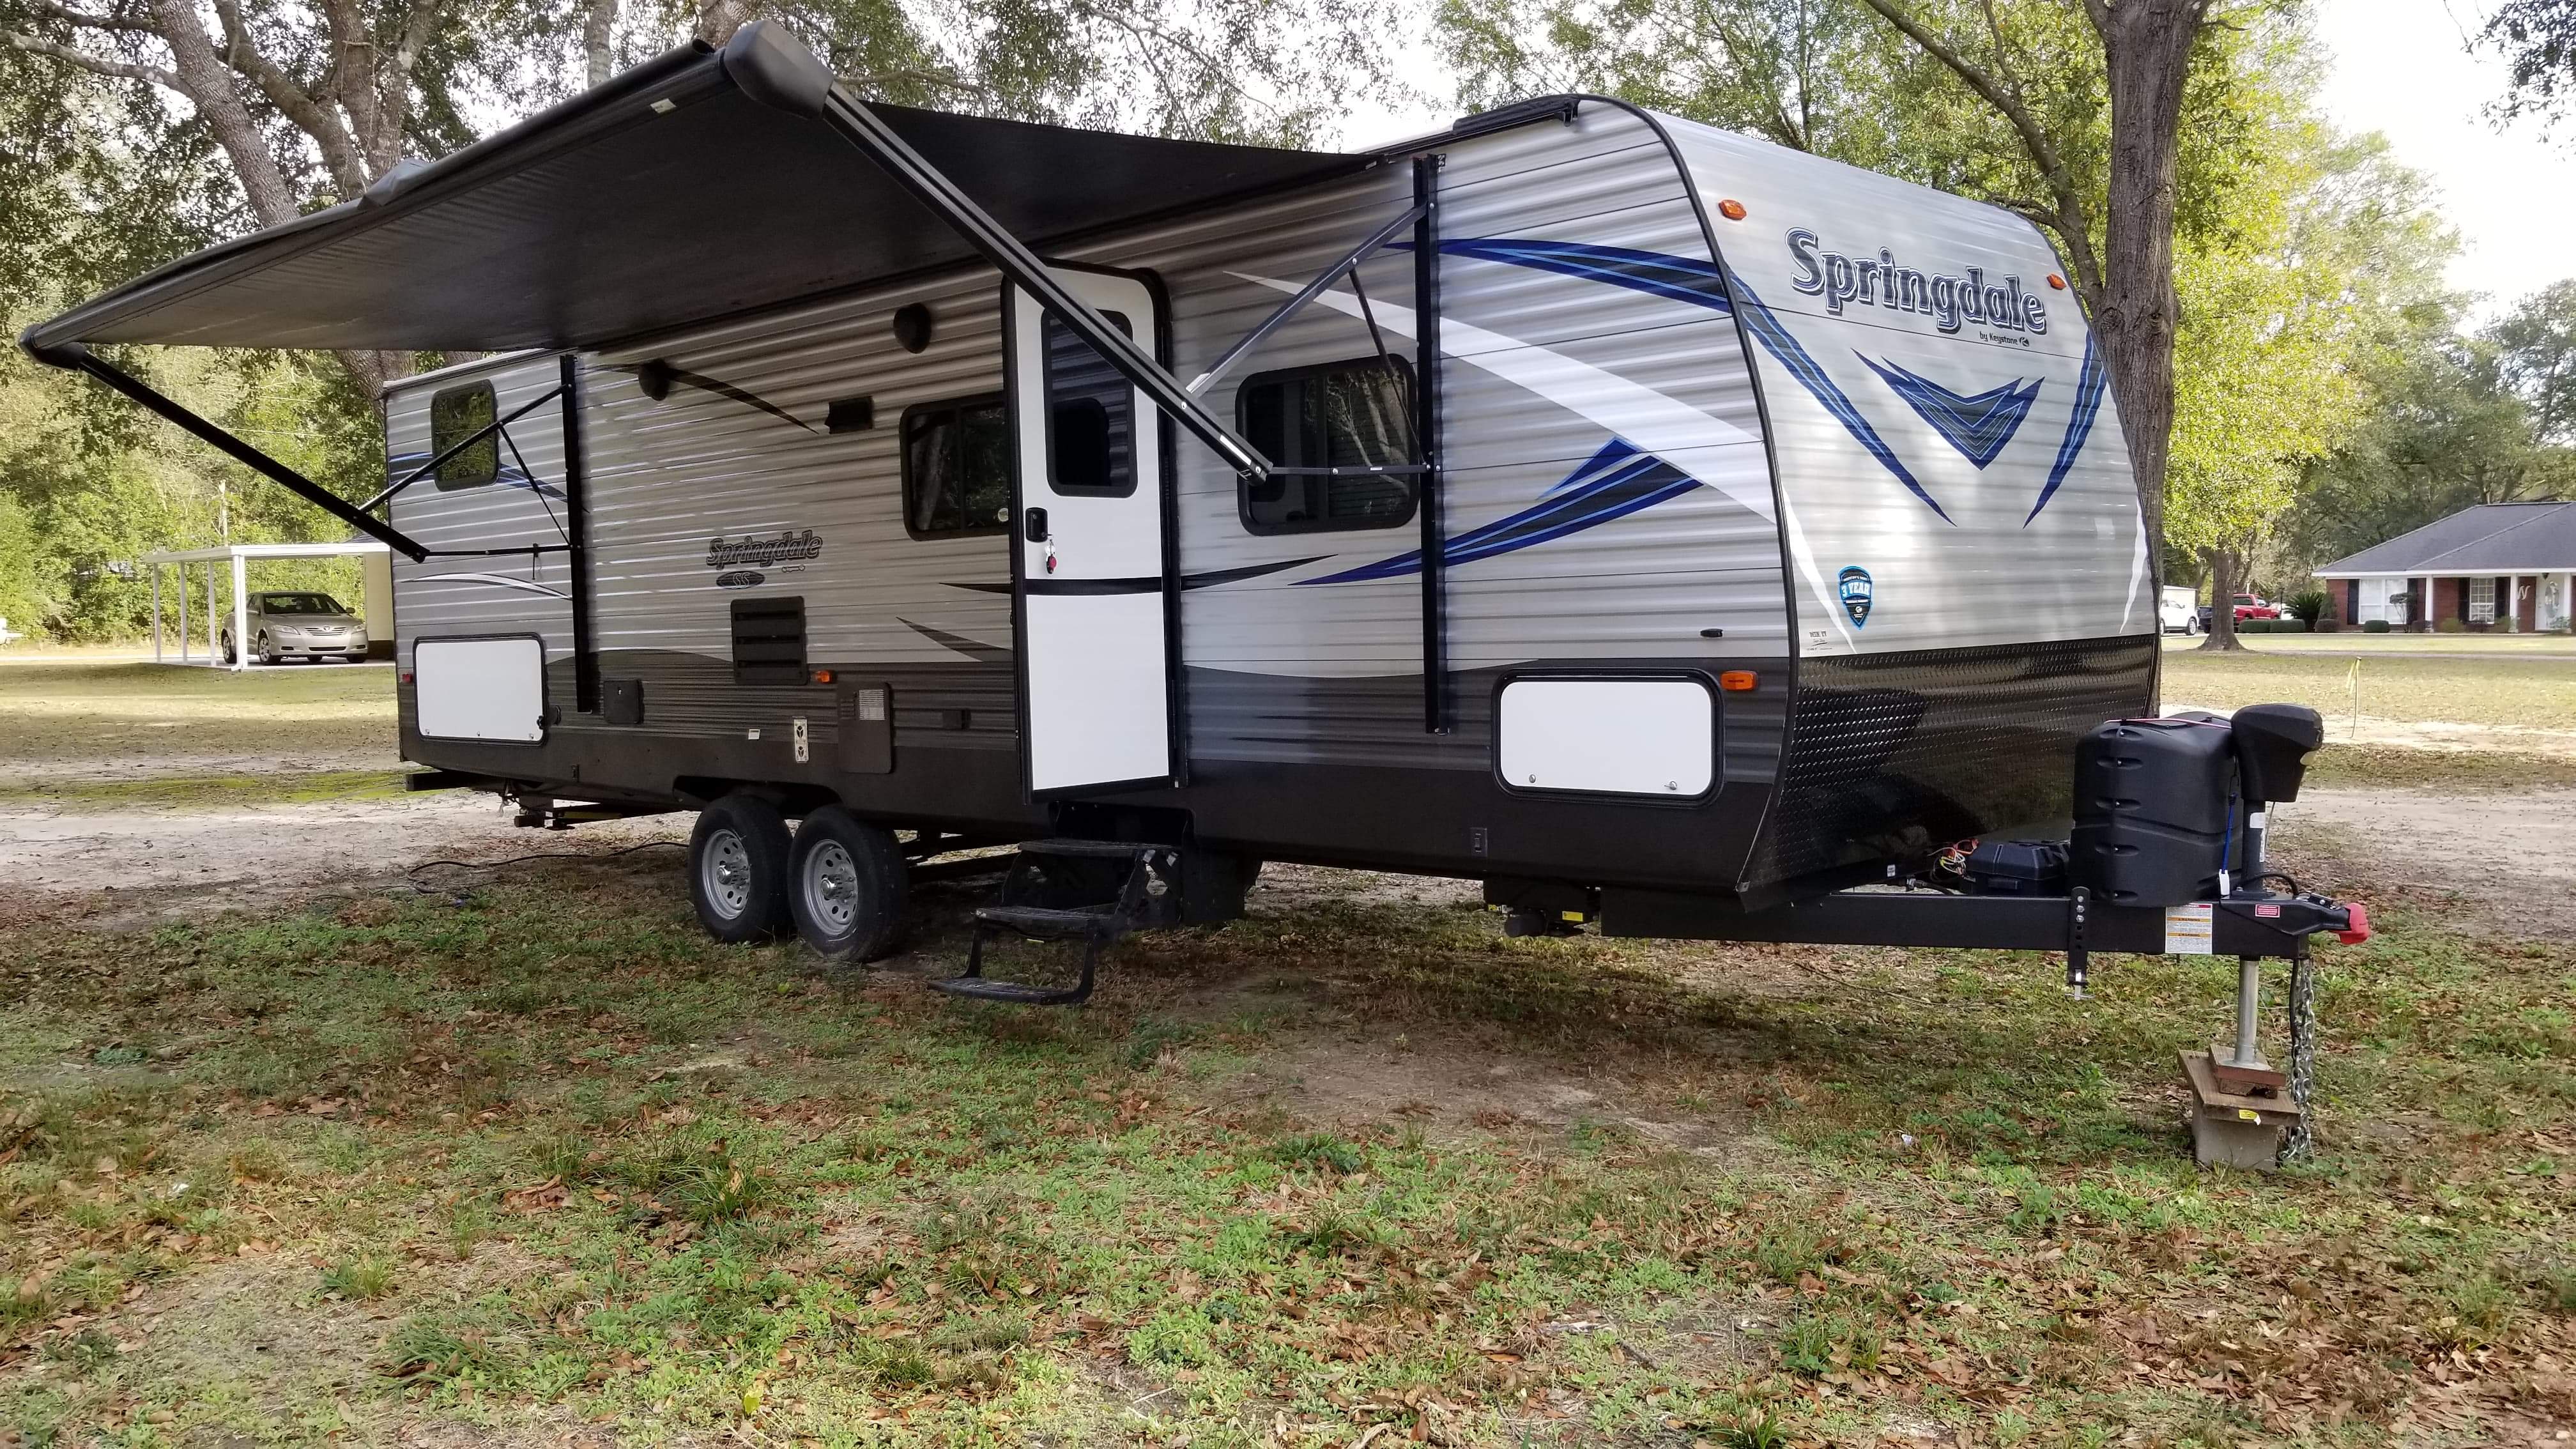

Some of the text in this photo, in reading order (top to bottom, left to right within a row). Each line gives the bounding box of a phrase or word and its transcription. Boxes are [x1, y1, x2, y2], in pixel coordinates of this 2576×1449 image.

[1785, 227, 2047, 335] Springdale
[1979, 330, 2018, 345] by Keystone
[707, 530, 823, 571] Springdale
[1848, 582, 1871, 596] YEAR
